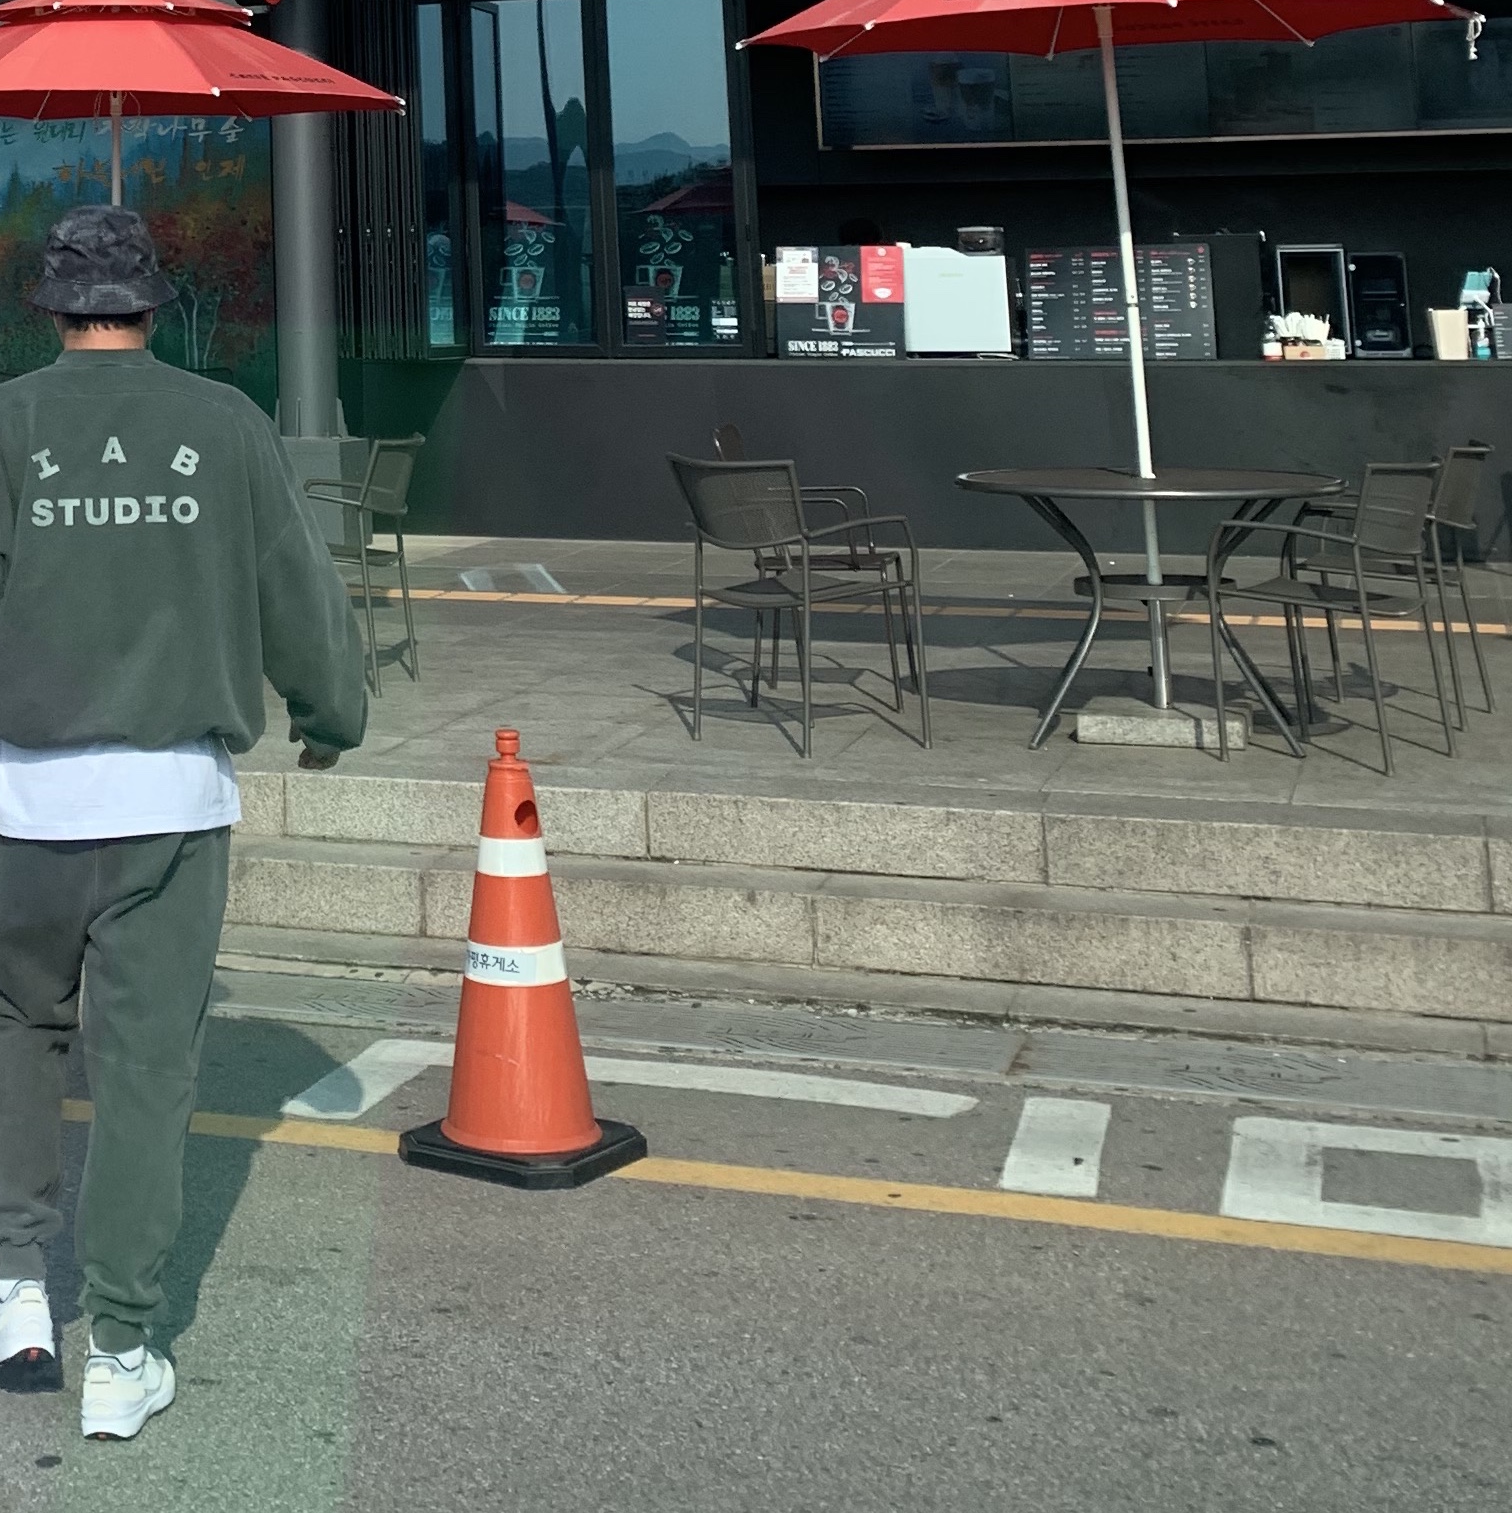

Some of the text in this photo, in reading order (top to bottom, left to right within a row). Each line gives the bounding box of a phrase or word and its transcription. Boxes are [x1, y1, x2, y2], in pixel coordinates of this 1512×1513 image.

[217, 116, 246, 144] 숲
[194, 154, 246, 181] 인제
[489, 306, 561, 321] SINCE 1883
[787, 340, 817, 352] SINCE
[841, 348, 896, 357] PASCUCCI
[31, 495, 199, 526] STUDIO
